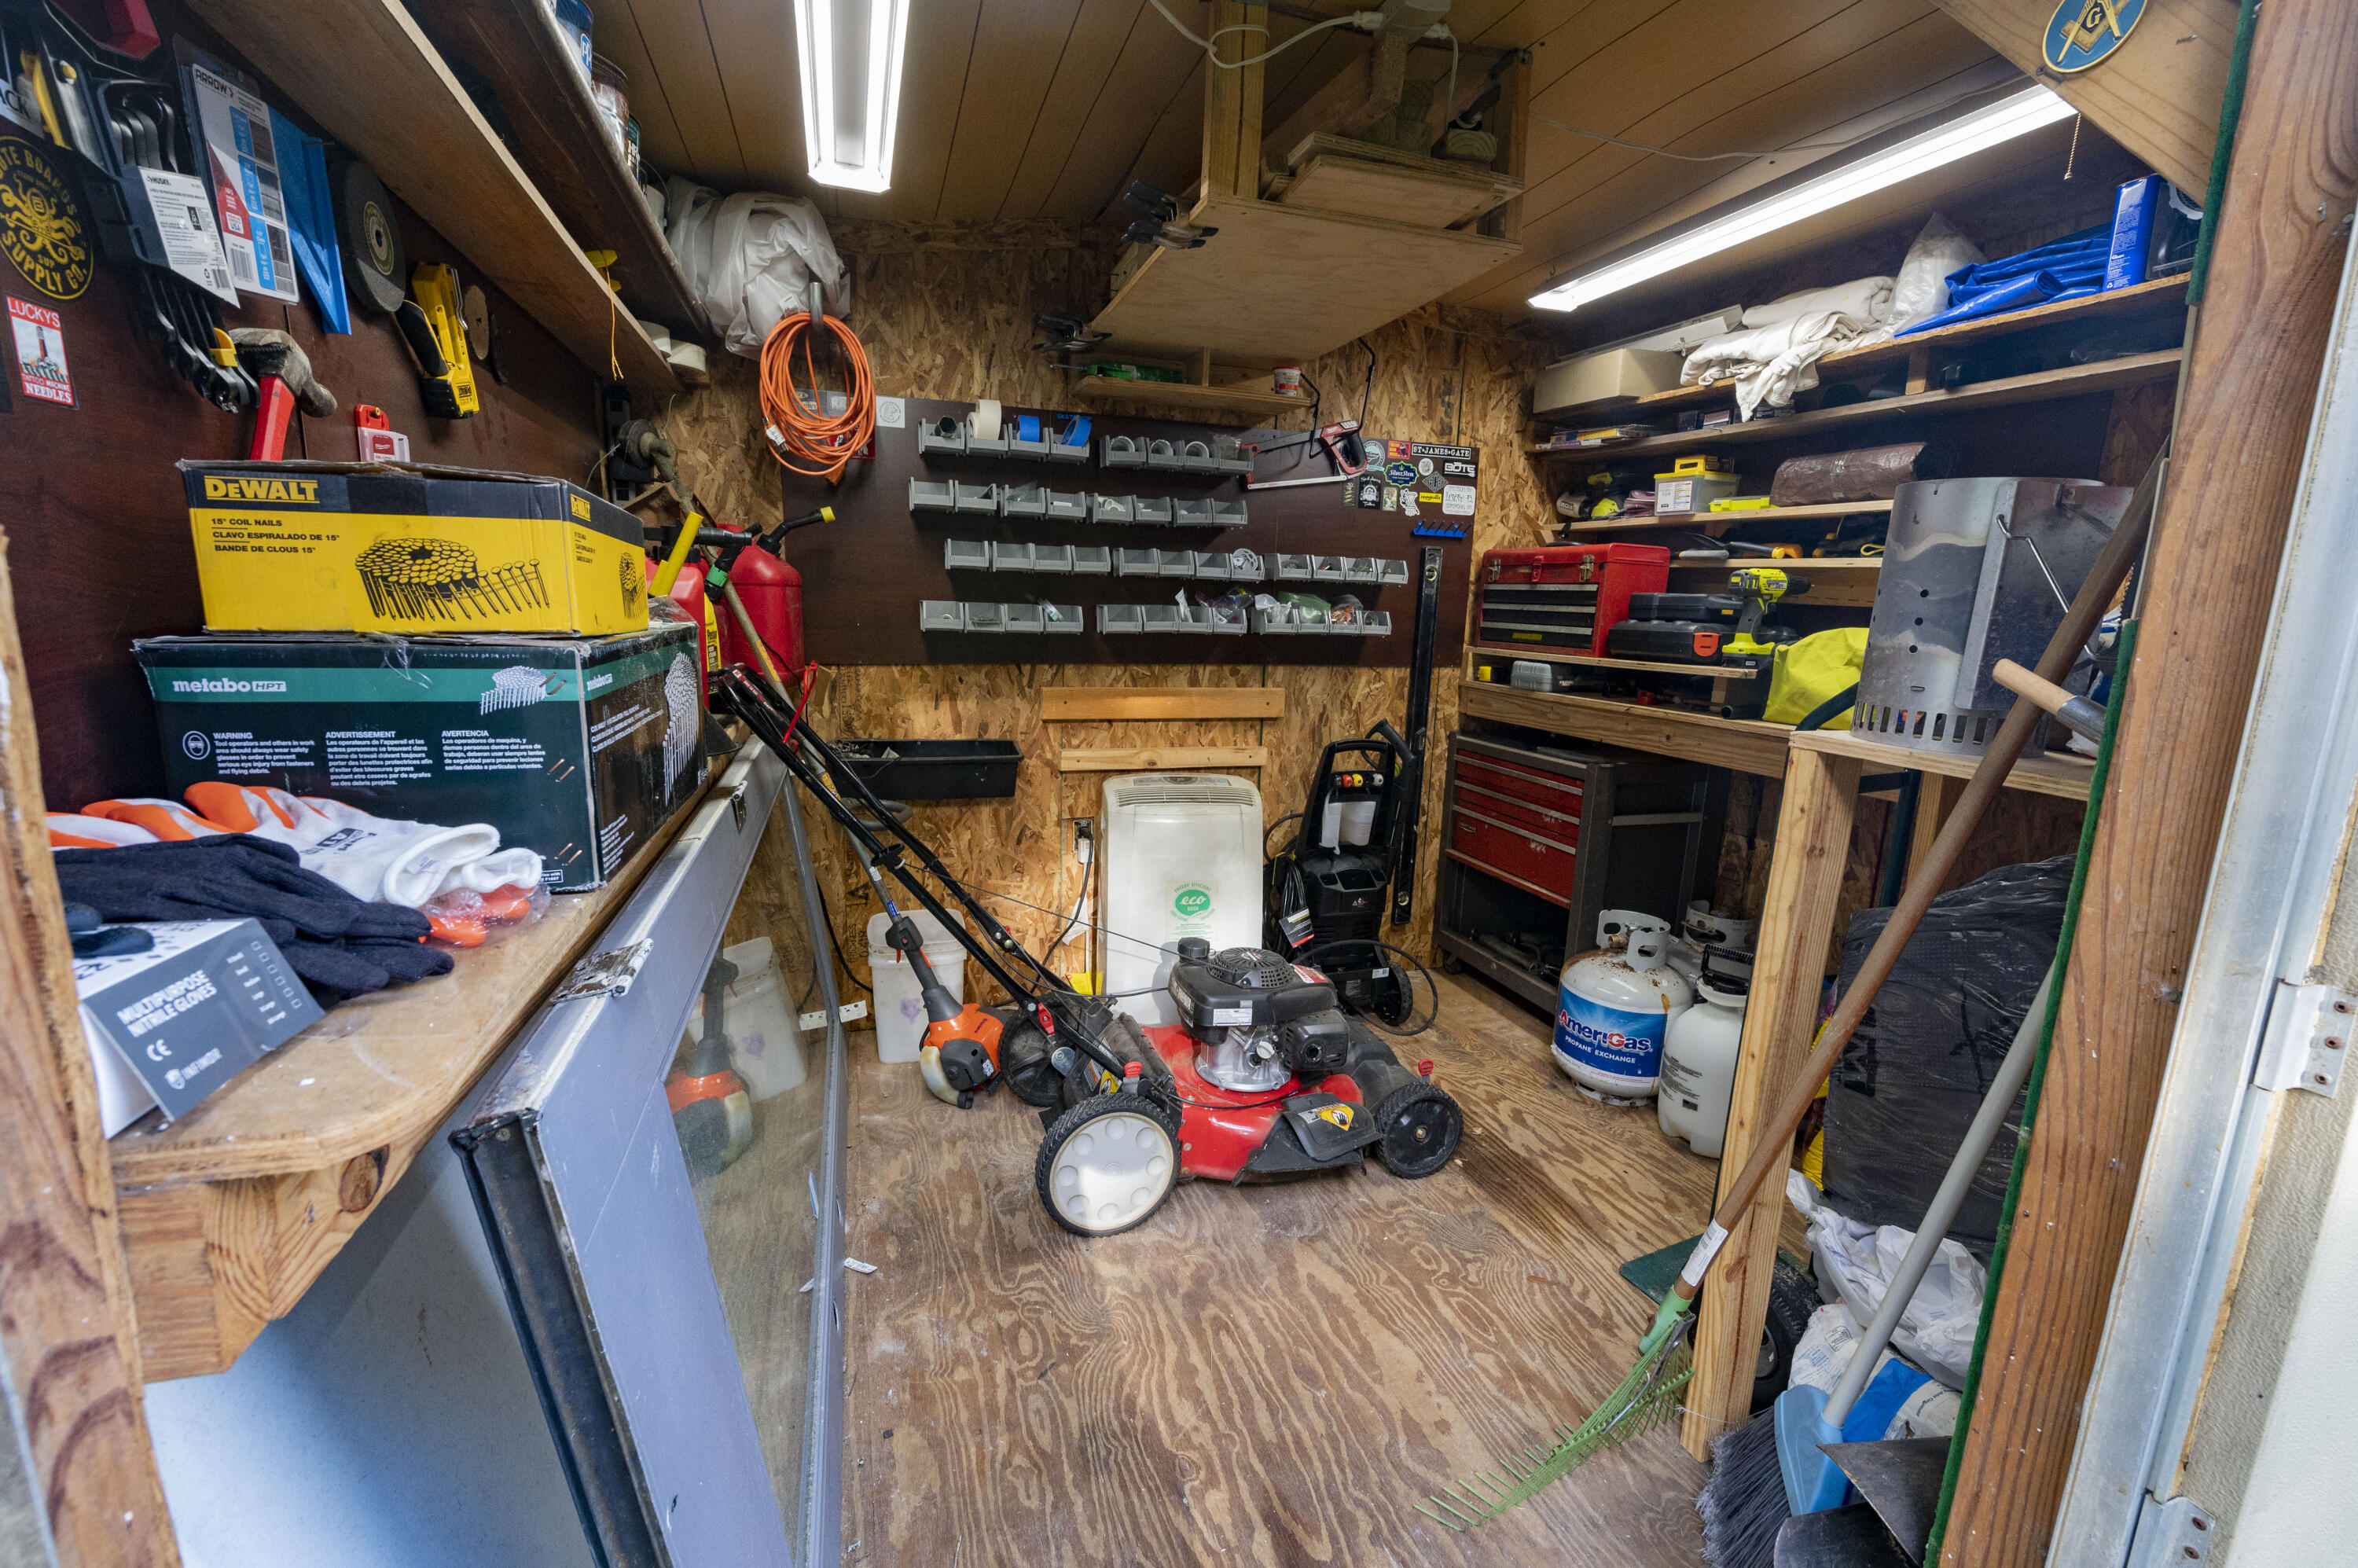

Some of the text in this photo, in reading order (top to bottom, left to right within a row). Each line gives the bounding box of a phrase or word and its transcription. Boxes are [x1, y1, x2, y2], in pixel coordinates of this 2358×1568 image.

[196, 68, 227, 94] ARROW
[2, 230, 63, 293] SUPPLY
[7, 297, 61, 328] LUCKYS
[22, 373, 44, 385] TATTOO
[24, 382, 72, 404] NEEDLES
[248, 532, 307, 541] ESPIRALADO
[172, 678, 285, 692] metabo HPT
[1179, 895, 1207, 905] eco
[116, 969, 210, 1025] MULTIPURPOSE
[127, 1006, 178, 1037] NITRILE
[174, 982, 217, 1015] GLOVES
[1559, 1009, 1651, 1052] AmeriGas
[1565, 1035, 1636, 1063] PROPANE EXCHANGE
